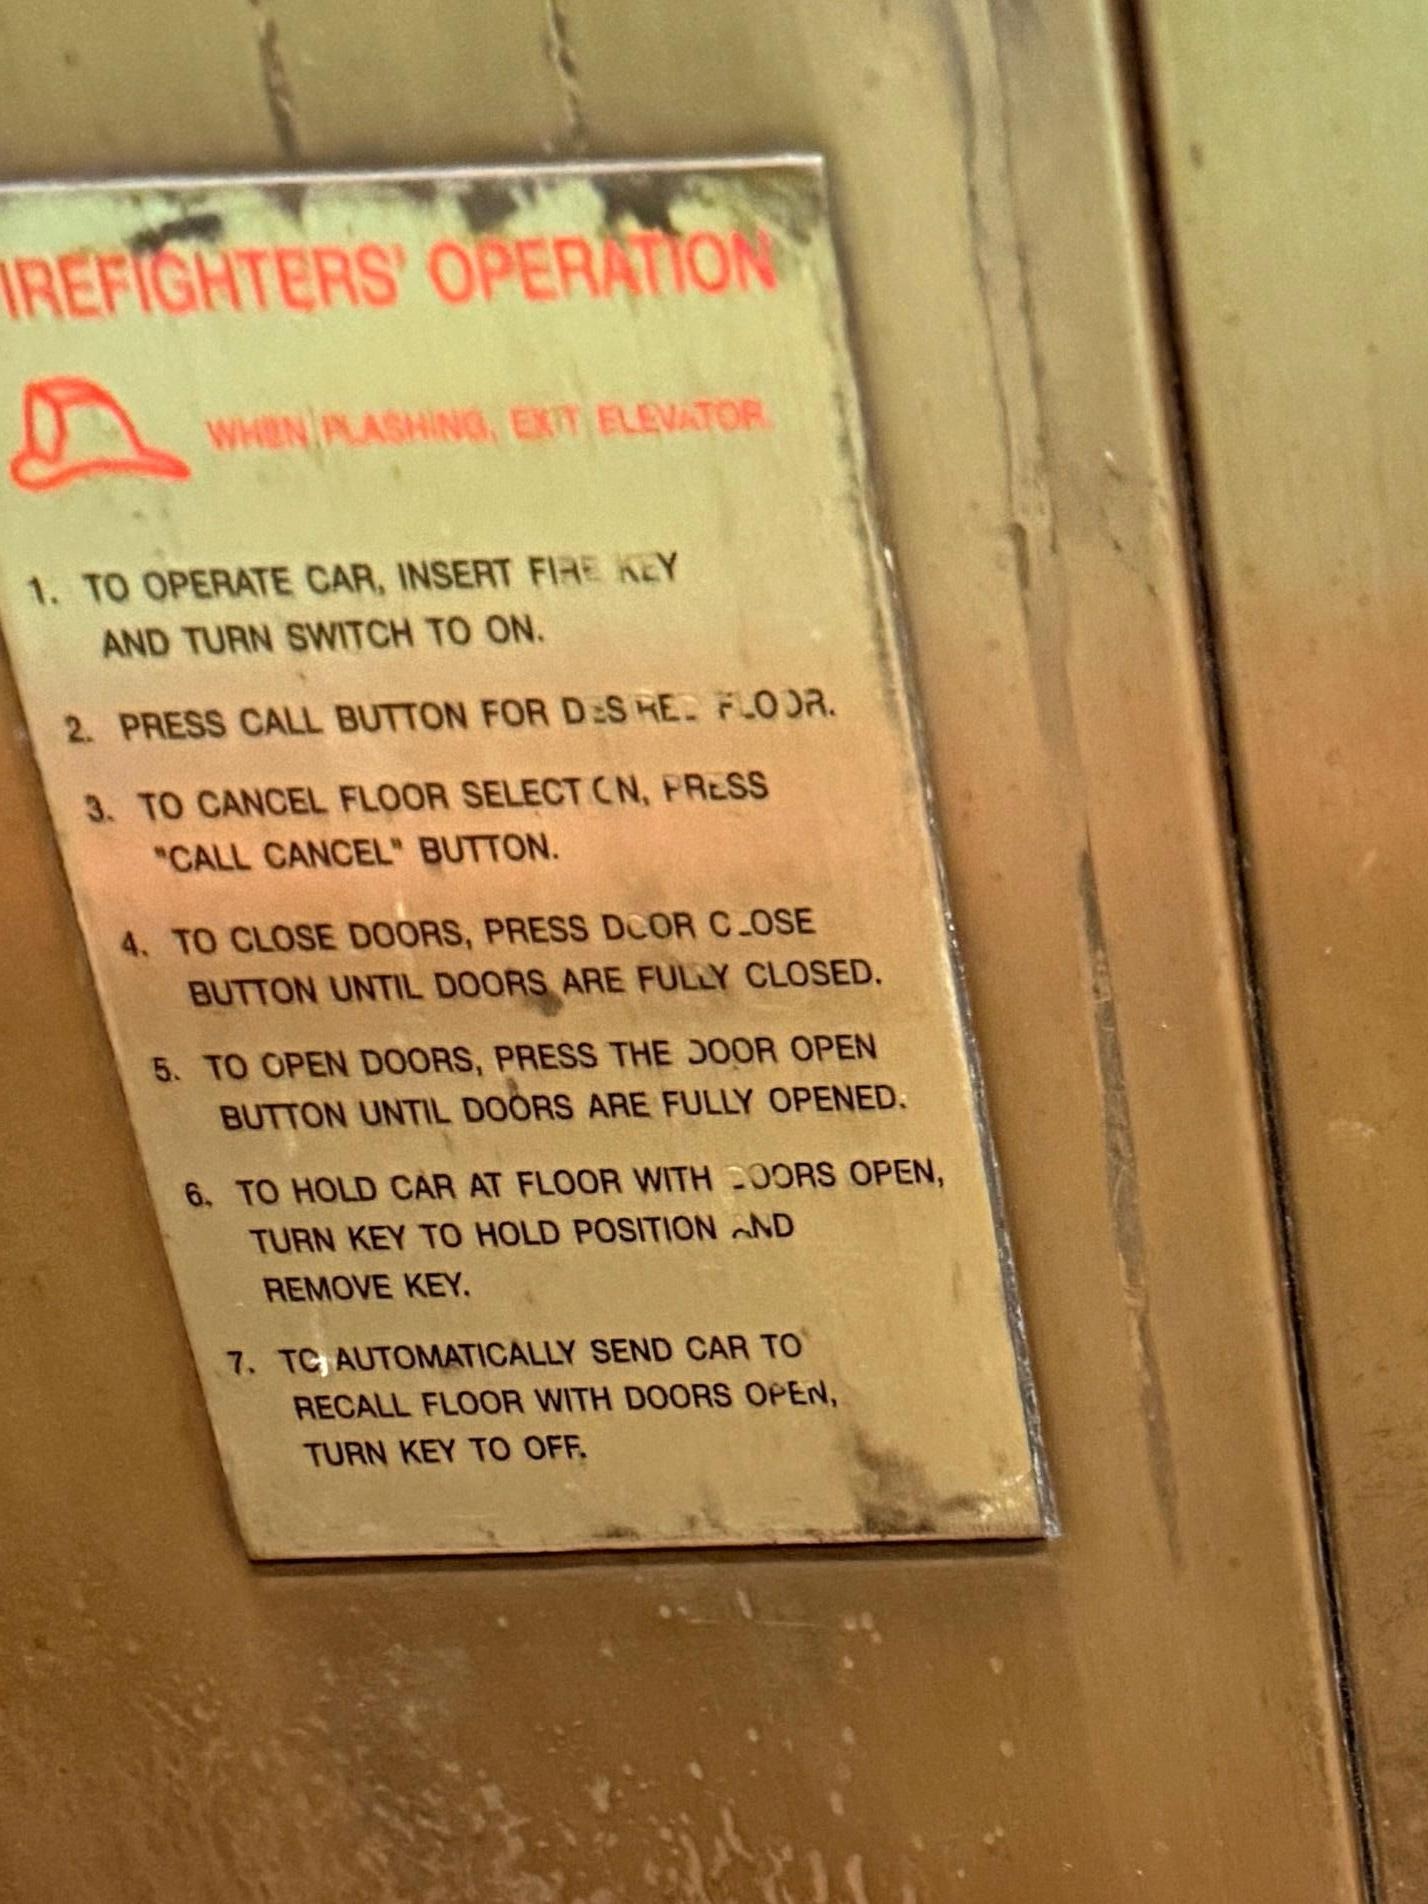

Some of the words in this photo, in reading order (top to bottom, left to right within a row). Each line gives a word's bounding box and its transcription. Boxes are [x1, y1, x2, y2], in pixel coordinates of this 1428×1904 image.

[0, 243, 406, 319] IREFIGHTERS'
[427, 228, 778, 305] OPERATION
[207, 415, 309, 450] WHEN
[508, 405, 579, 441] EXIT
[28, 576, 58, 606] 1.
[81, 572, 130, 605] TO
[142, 566, 294, 603] OPERATE
[305, 562, 386, 597] CAR,
[397, 557, 512, 591] INSERT
[528, 555, 600, 588] FIRE
[618, 551, 678, 584] KEY
[103, 627, 170, 659] AND
[181, 624, 274, 656] TURN
[285, 616, 414, 654] SWITCH
[424, 615, 472, 647] TO
[486, 613, 544, 645] ON.
[64, 714, 93, 744] 2.
[118, 709, 227, 741] PRESS
[239, 706, 324, 738] CALL
[334, 701, 469, 734] BUTTON
[480, 698, 550, 728] FOR
[84, 794, 115, 824] 3.
[137, 791, 184, 822] TO
[197, 787, 329, 819] CANCEL
[339, 782, 450, 816] FLOOR
[154, 843, 252, 873] "CALL
[263, 837, 403, 870] CANCEL"
[418, 831, 560, 866] BUTTON.
[121, 930, 148, 957] 4.
[171, 927, 217, 955] TO
[230, 923, 338, 953] CLOSE
[347, 919, 472, 950] DOORS,
[483, 914, 590, 945] PRESS
[188, 976, 318, 1007] BUTTON
[328, 973, 424, 1003] UNTIL
[433, 966, 550, 1002] DOORS
[563, 966, 626, 995] ARE
[745, 959, 882, 989] CLOSED.
[151, 1057, 180, 1083] 5.
[202, 1053, 248, 1081] TO
[261, 1050, 350, 1079] OPEN
[358, 1046, 483, 1077] DOORS,
[493, 1042, 598, 1072] PRESS
[607, 1039, 673, 1070] THE
[791, 1032, 877, 1063] OPEN
[219, 1101, 348, 1131] BUTTON
[358, 1097, 453, 1127] UNTIL
[461, 1091, 576, 1125] DOORS
[589, 1091, 652, 1119] ARE
[662, 1088, 753, 1118] FULLY
[769, 1084, 907, 1113] OPENED.
[184, 1182, 213, 1208] 6.
[235, 1179, 279, 1206] TO
[291, 1176, 377, 1205] HOLD
[389, 1170, 458, 1201] CAR
[470, 1171, 502, 1198] AT
[516, 1168, 623, 1198] FLOOR
[632, 1165, 713, 1195] WITH
[732, 1161, 837, 1191] OORS
[850, 1157, 944, 1188] OPEN,
[248, 1227, 336, 1255] TURN
[347, 1224, 405, 1252] KEY
[417, 1223, 463, 1249] TO
[474, 1220, 560, 1248] HOLD
[572, 1214, 718, 1244] POSITION
[262, 1274, 393, 1303] REMOVE
[403, 1272, 470, 1298] KEY.
[226, 1351, 255, 1376] 7.
[336, 1339, 575, 1374] AUTOMATICALLY
[590, 1337, 673, 1364] SEND
[686, 1334, 750, 1362] CAR
[760, 1329, 804, 1361] TO
[293, 1392, 412, 1421] RECALL
[421, 1389, 525, 1416] FLOOR
[533, 1386, 613, 1413] WITH
[624, 1382, 733, 1410] DOORS
[745, 1379, 837, 1408] OPEN,
[302, 1440, 388, 1467] TURN
[399, 1438, 455, 1465] KEY
[467, 1436, 511, 1462] TO
[523, 1434, 587, 1460] OFF.
